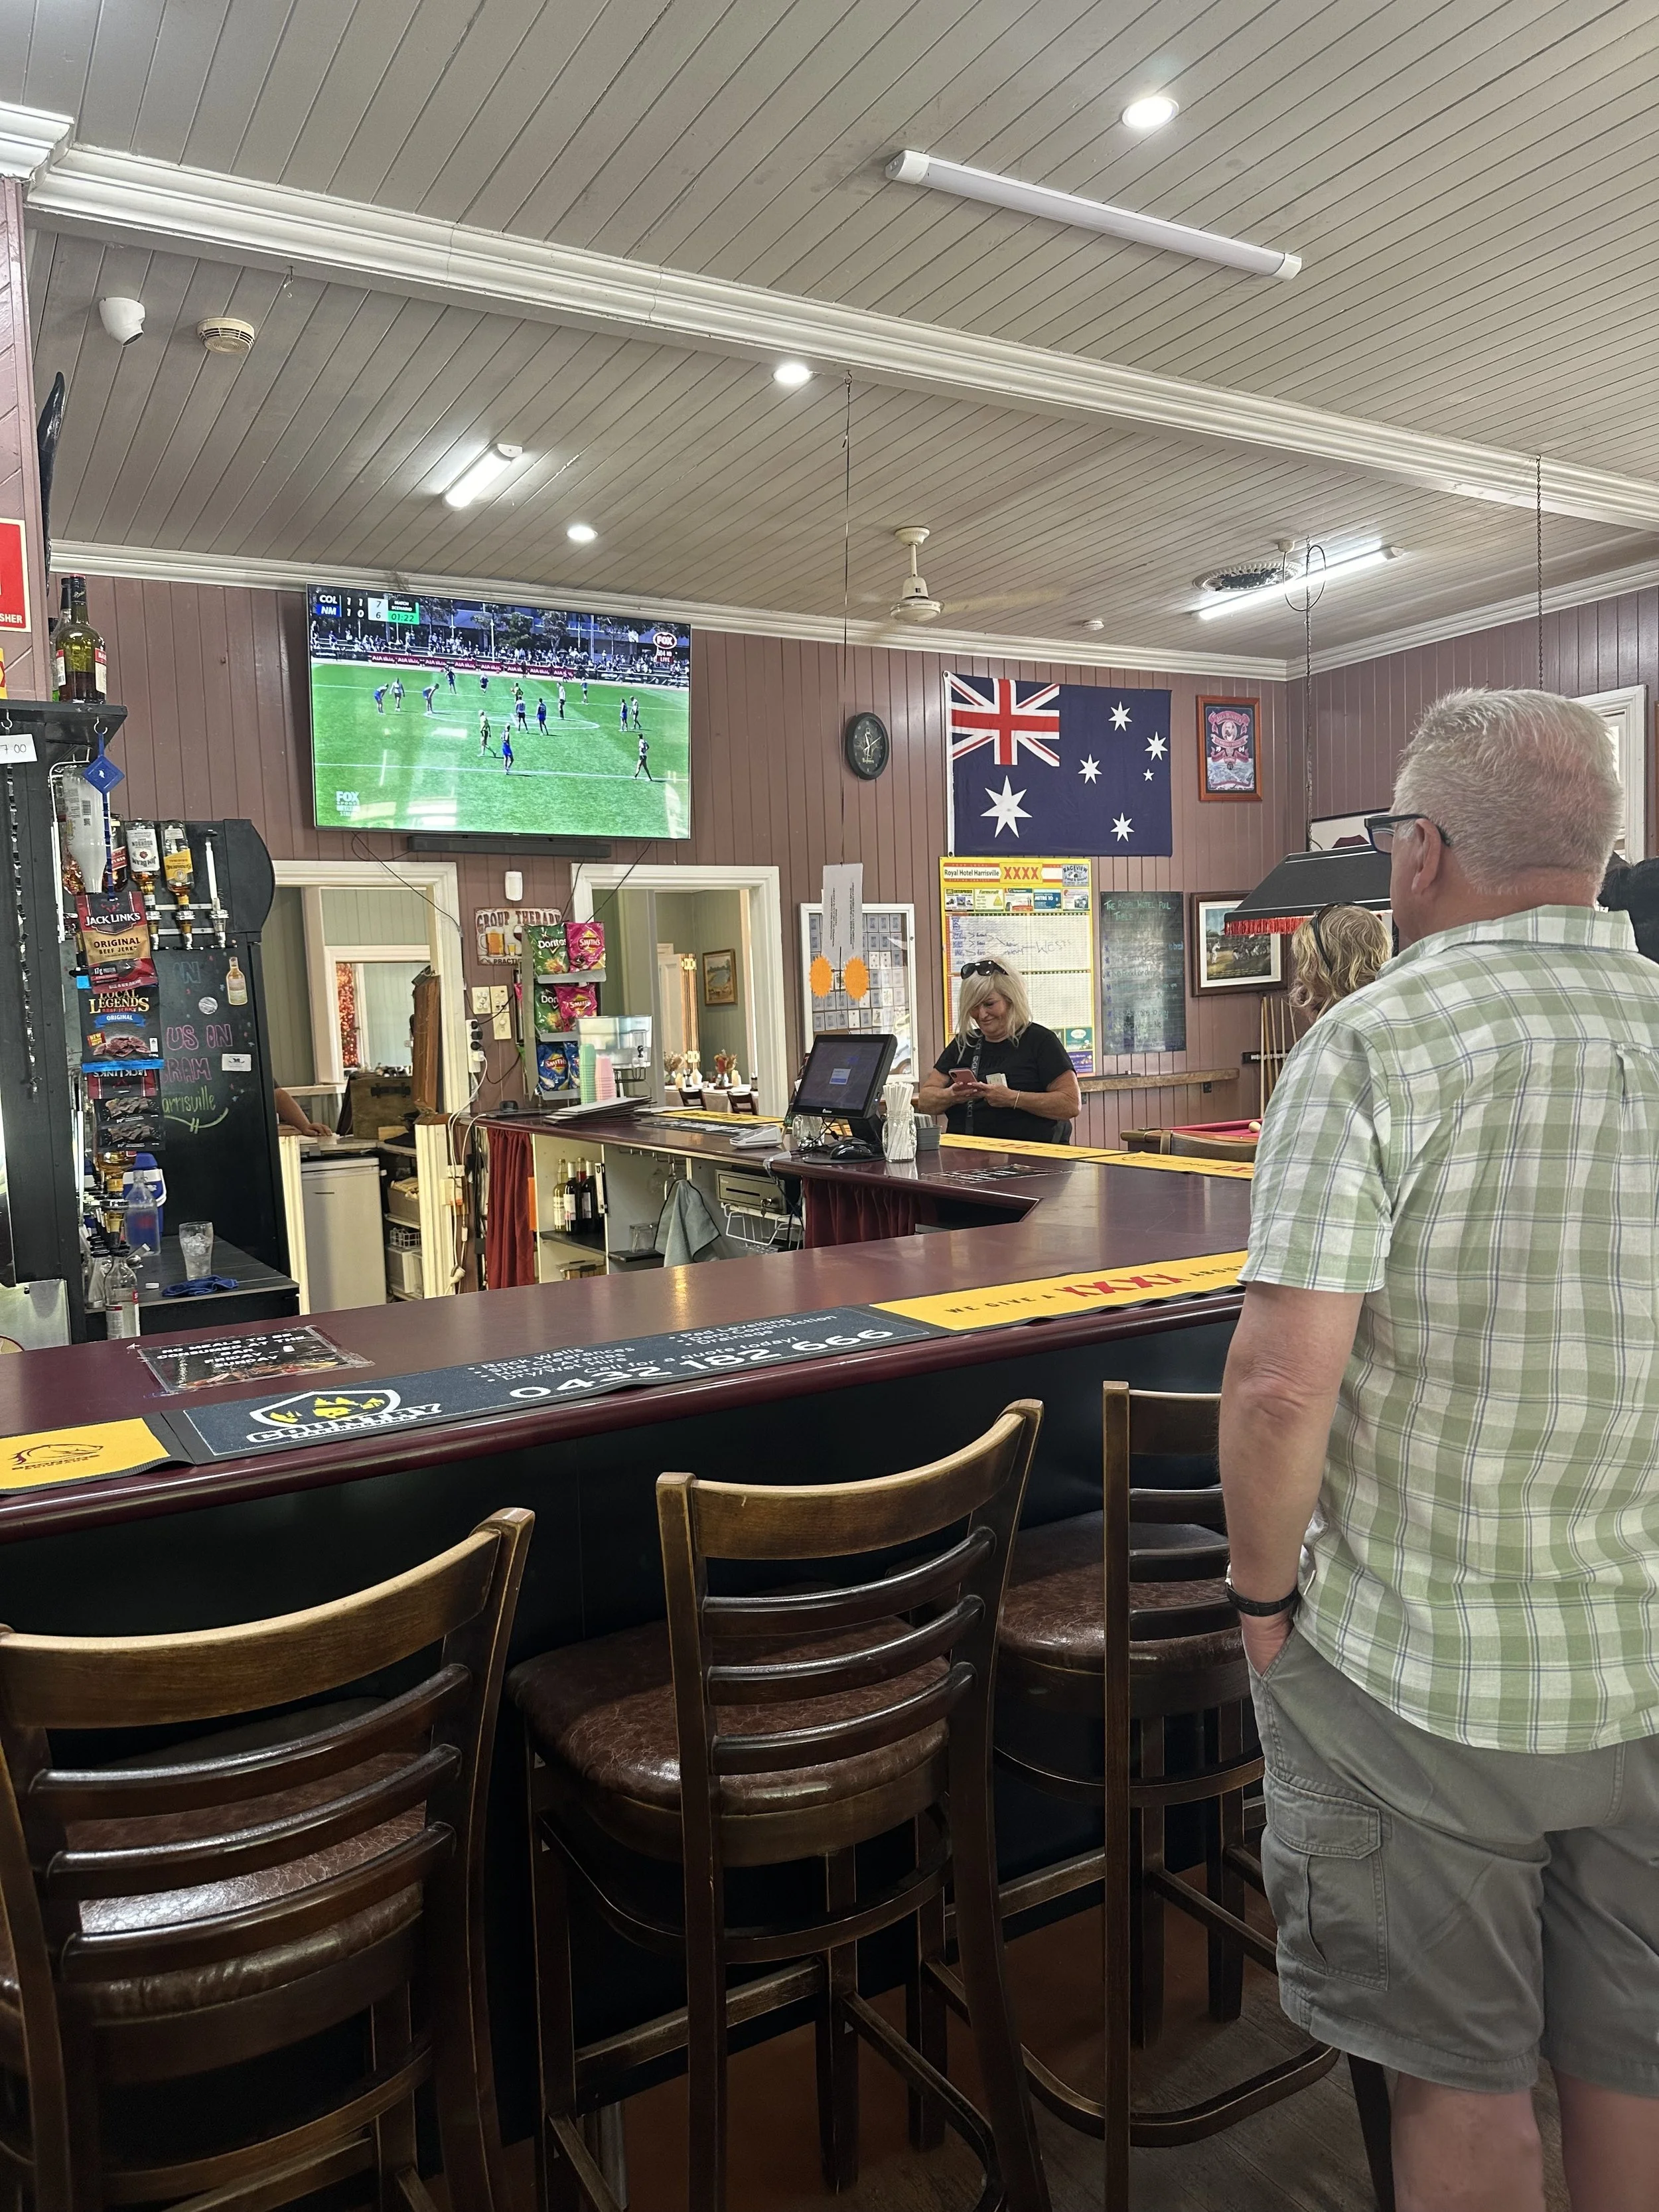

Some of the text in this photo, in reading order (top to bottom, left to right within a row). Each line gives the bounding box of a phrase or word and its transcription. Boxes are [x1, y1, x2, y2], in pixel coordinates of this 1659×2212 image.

[319, 595, 337, 605] COL
[359, 598, 363, 607] 1
[321, 606, 336, 615] NM
[346, 608, 351, 617] 1
[357, 609, 365, 618] 0
[391, 613, 414, 622] 01:22
[657, 635, 673, 645] FOX
[336, 791, 360, 802] FOX
[1003, 867, 1039, 880] XXXX
[1104, 900, 1116, 911] THE
[85, 915, 111, 926] JACK
[477, 911, 510, 934] GROUP
[94, 937, 141, 948] ORIGINAL
[89, 997, 150, 1014] LEGENDS
[166, 1025, 198, 1051] US
[944, 1304, 979, 1313] WE
[985, 1296, 1035, 1307] GIVE
[1054, 1273, 1191, 1297] XXXX
[680, 1317, 792, 1339] Pad Levelling
[689, 1315, 837, 1342] Dam Construction
[696, 1329, 774, 1345] Drainage
[157, 1345, 242, 1359] CONSUMED
[188, 1341, 242, 1351] MEALS
[204, 1351, 263, 1364] FRIDAY
[213, 1355, 278, 1368] SUNDAY
[481, 1348, 584, 1369] Rock Walls
[488, 1347, 636, 1373] Site Clearances
[510, 1329, 894, 1398] 0432 182 666
[584, 1364, 622, 1374] Call
[681, 1347, 735, 1361] quote
[739, 1337, 799, 1350] today!
[495, 1353, 626, 1376] Horse Arenas
[502, 1357, 628, 1381] Dry/Wet Hire
[246, 1403, 442, 1443] COUNTRY
